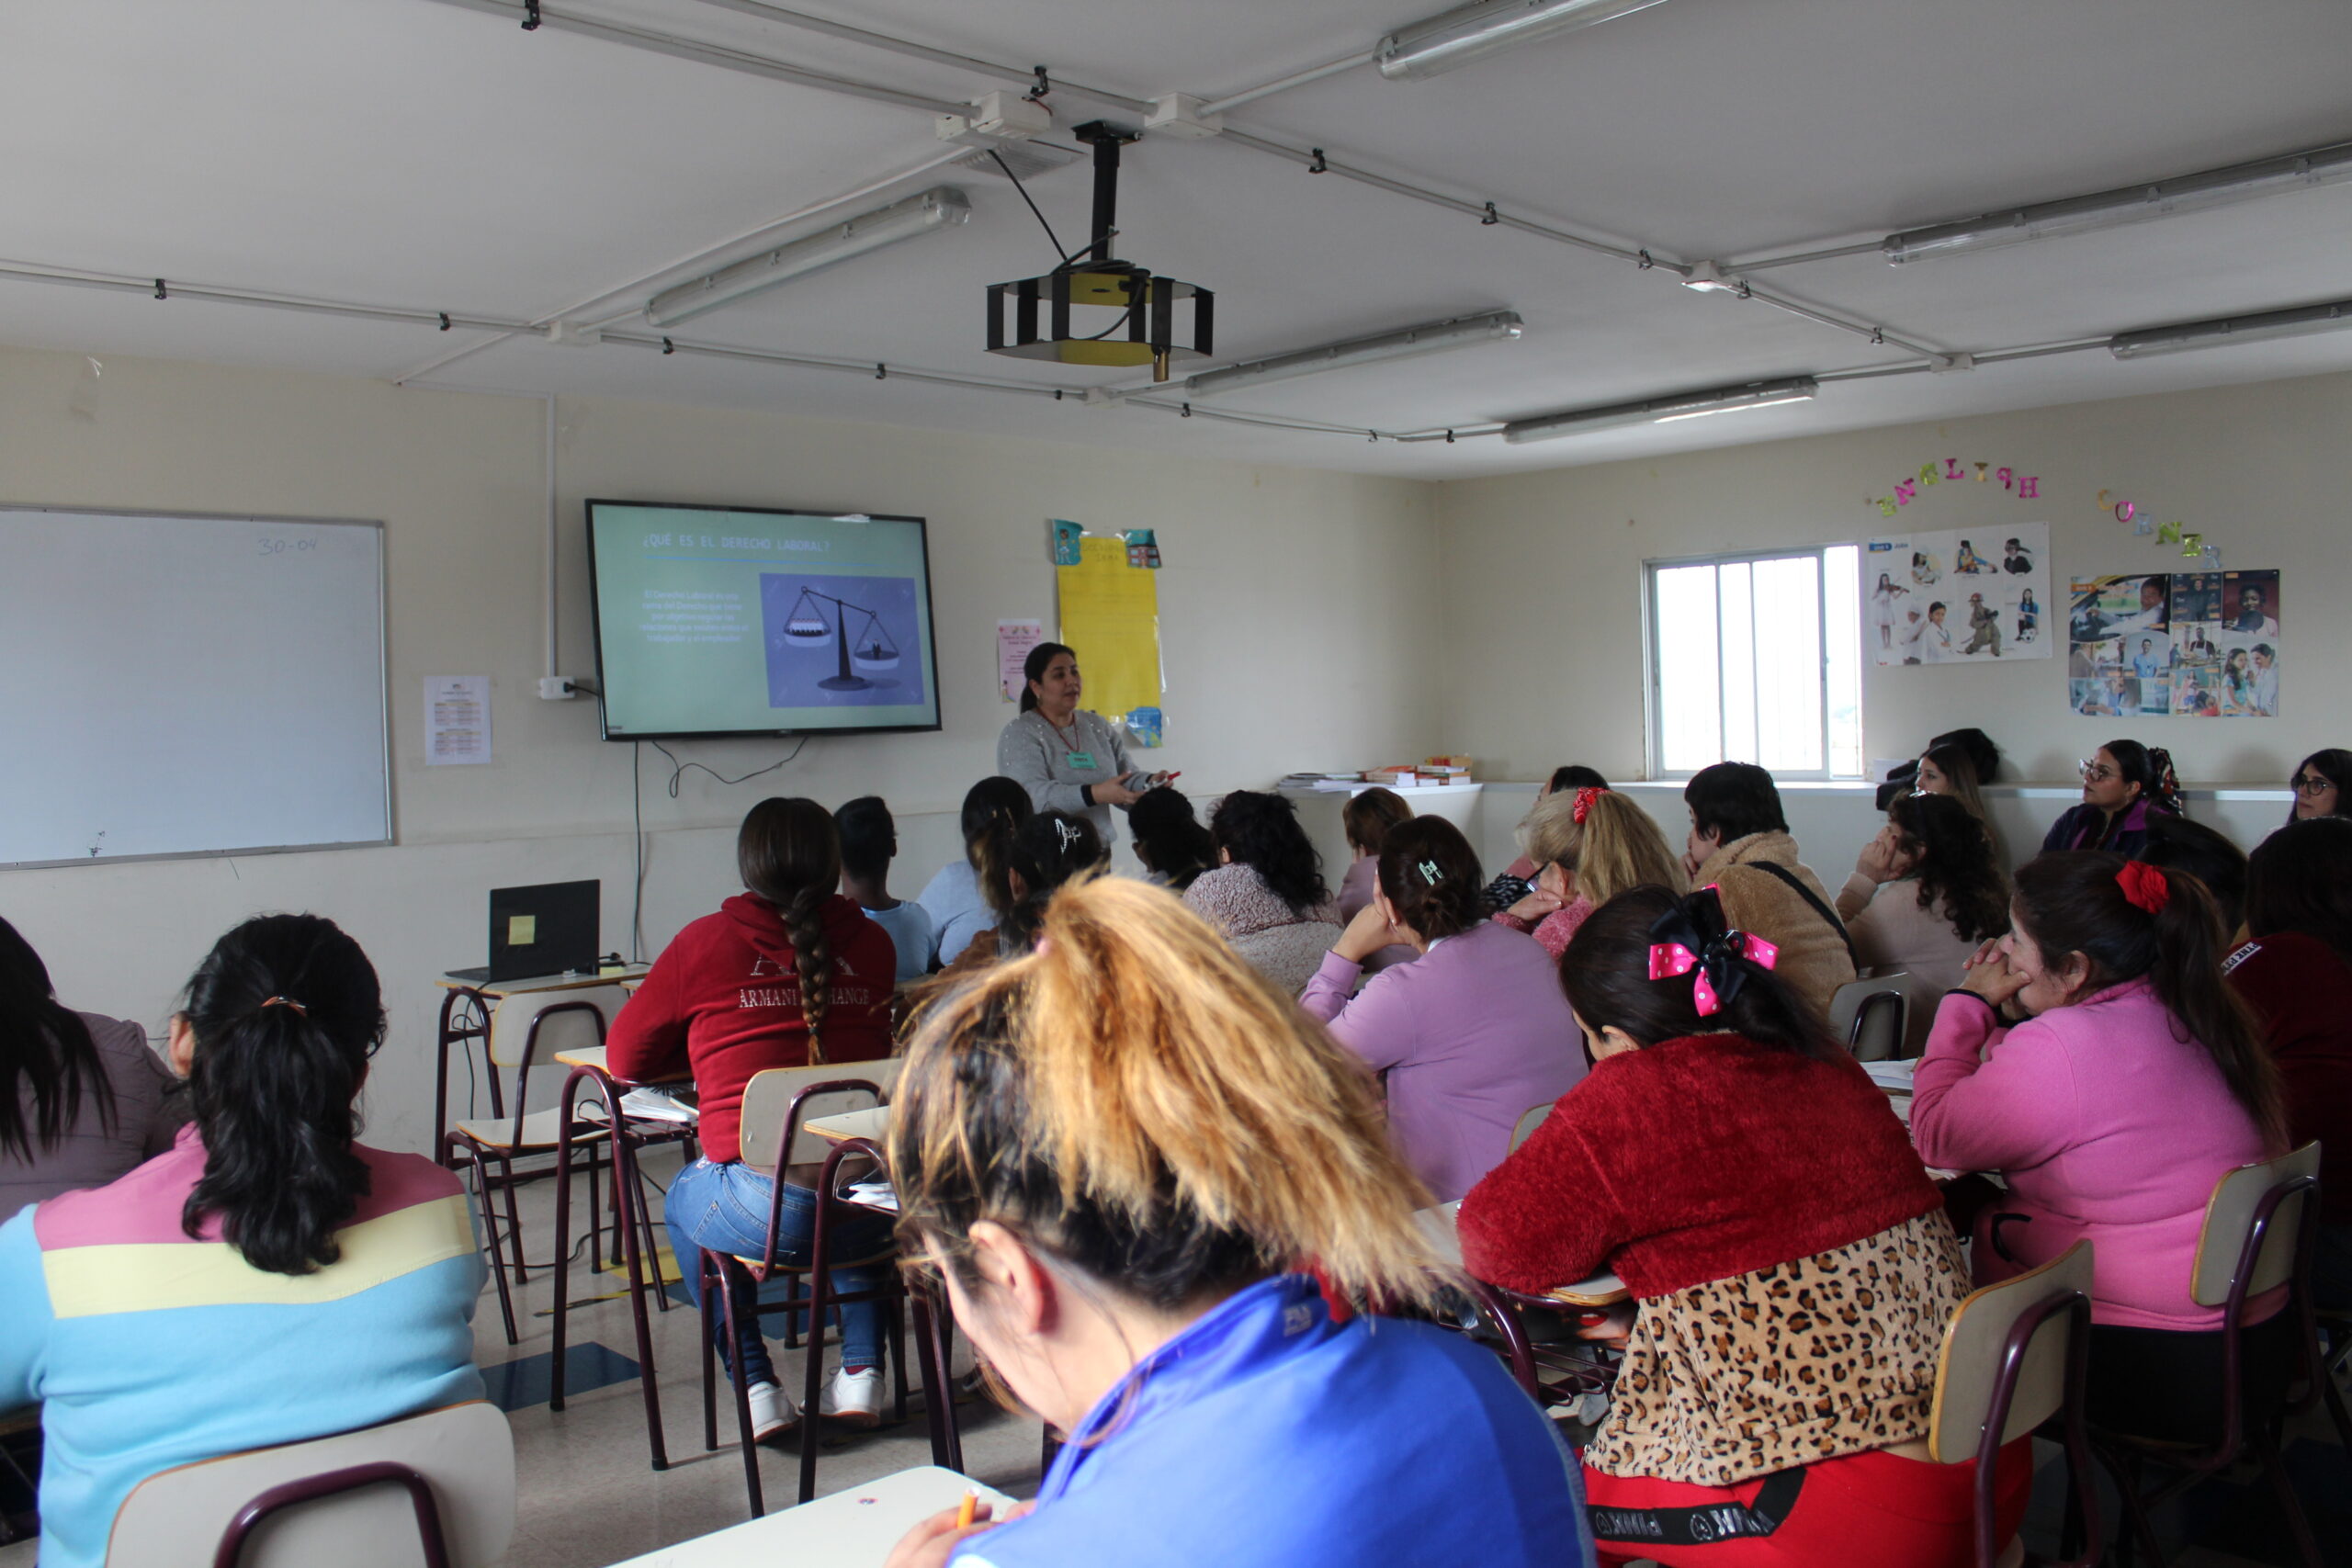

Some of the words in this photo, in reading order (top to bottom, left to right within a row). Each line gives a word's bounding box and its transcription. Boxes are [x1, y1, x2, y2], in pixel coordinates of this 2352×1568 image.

[2098, 489, 2222, 569] CORNER
[257, 536, 318, 557] 30-04
[643, 533, 672, 548] ¿QUÉ
[679, 535, 694, 547] ES
[701, 536, 716, 548] EL
[721, 536, 772, 550] DERECHO
[777, 538, 831, 552] LABORAL?
[739, 988, 797, 1008] ARMANI
[800, 987, 869, 1006] HANGE
